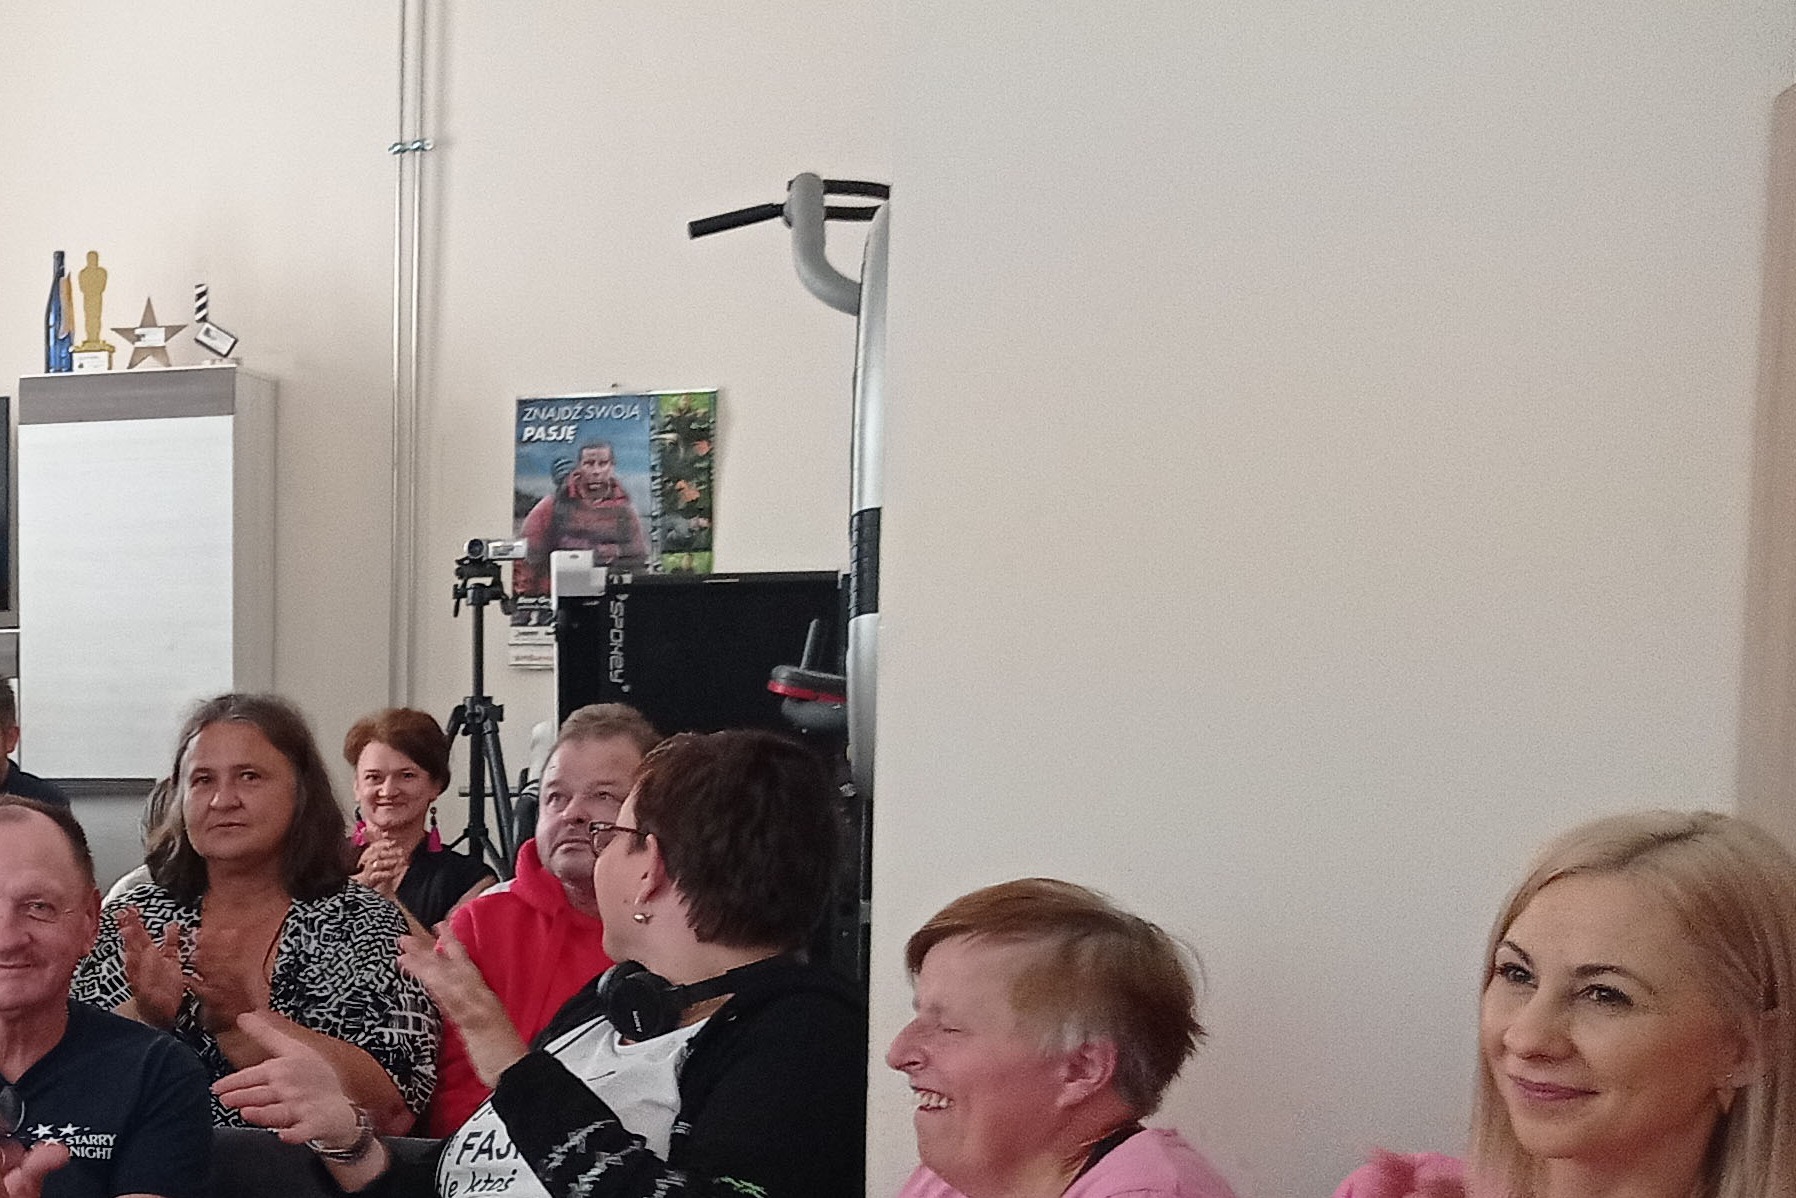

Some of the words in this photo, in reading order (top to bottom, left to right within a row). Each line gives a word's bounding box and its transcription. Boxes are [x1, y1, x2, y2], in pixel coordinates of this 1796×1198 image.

[522, 402, 583, 421] ZNAJDŹ
[522, 424, 578, 444] PASJĘ
[65, 1133, 117, 1147] STARRY
[455, 1129, 519, 1166] FAJ
[69, 1145, 113, 1160] NIGHT
